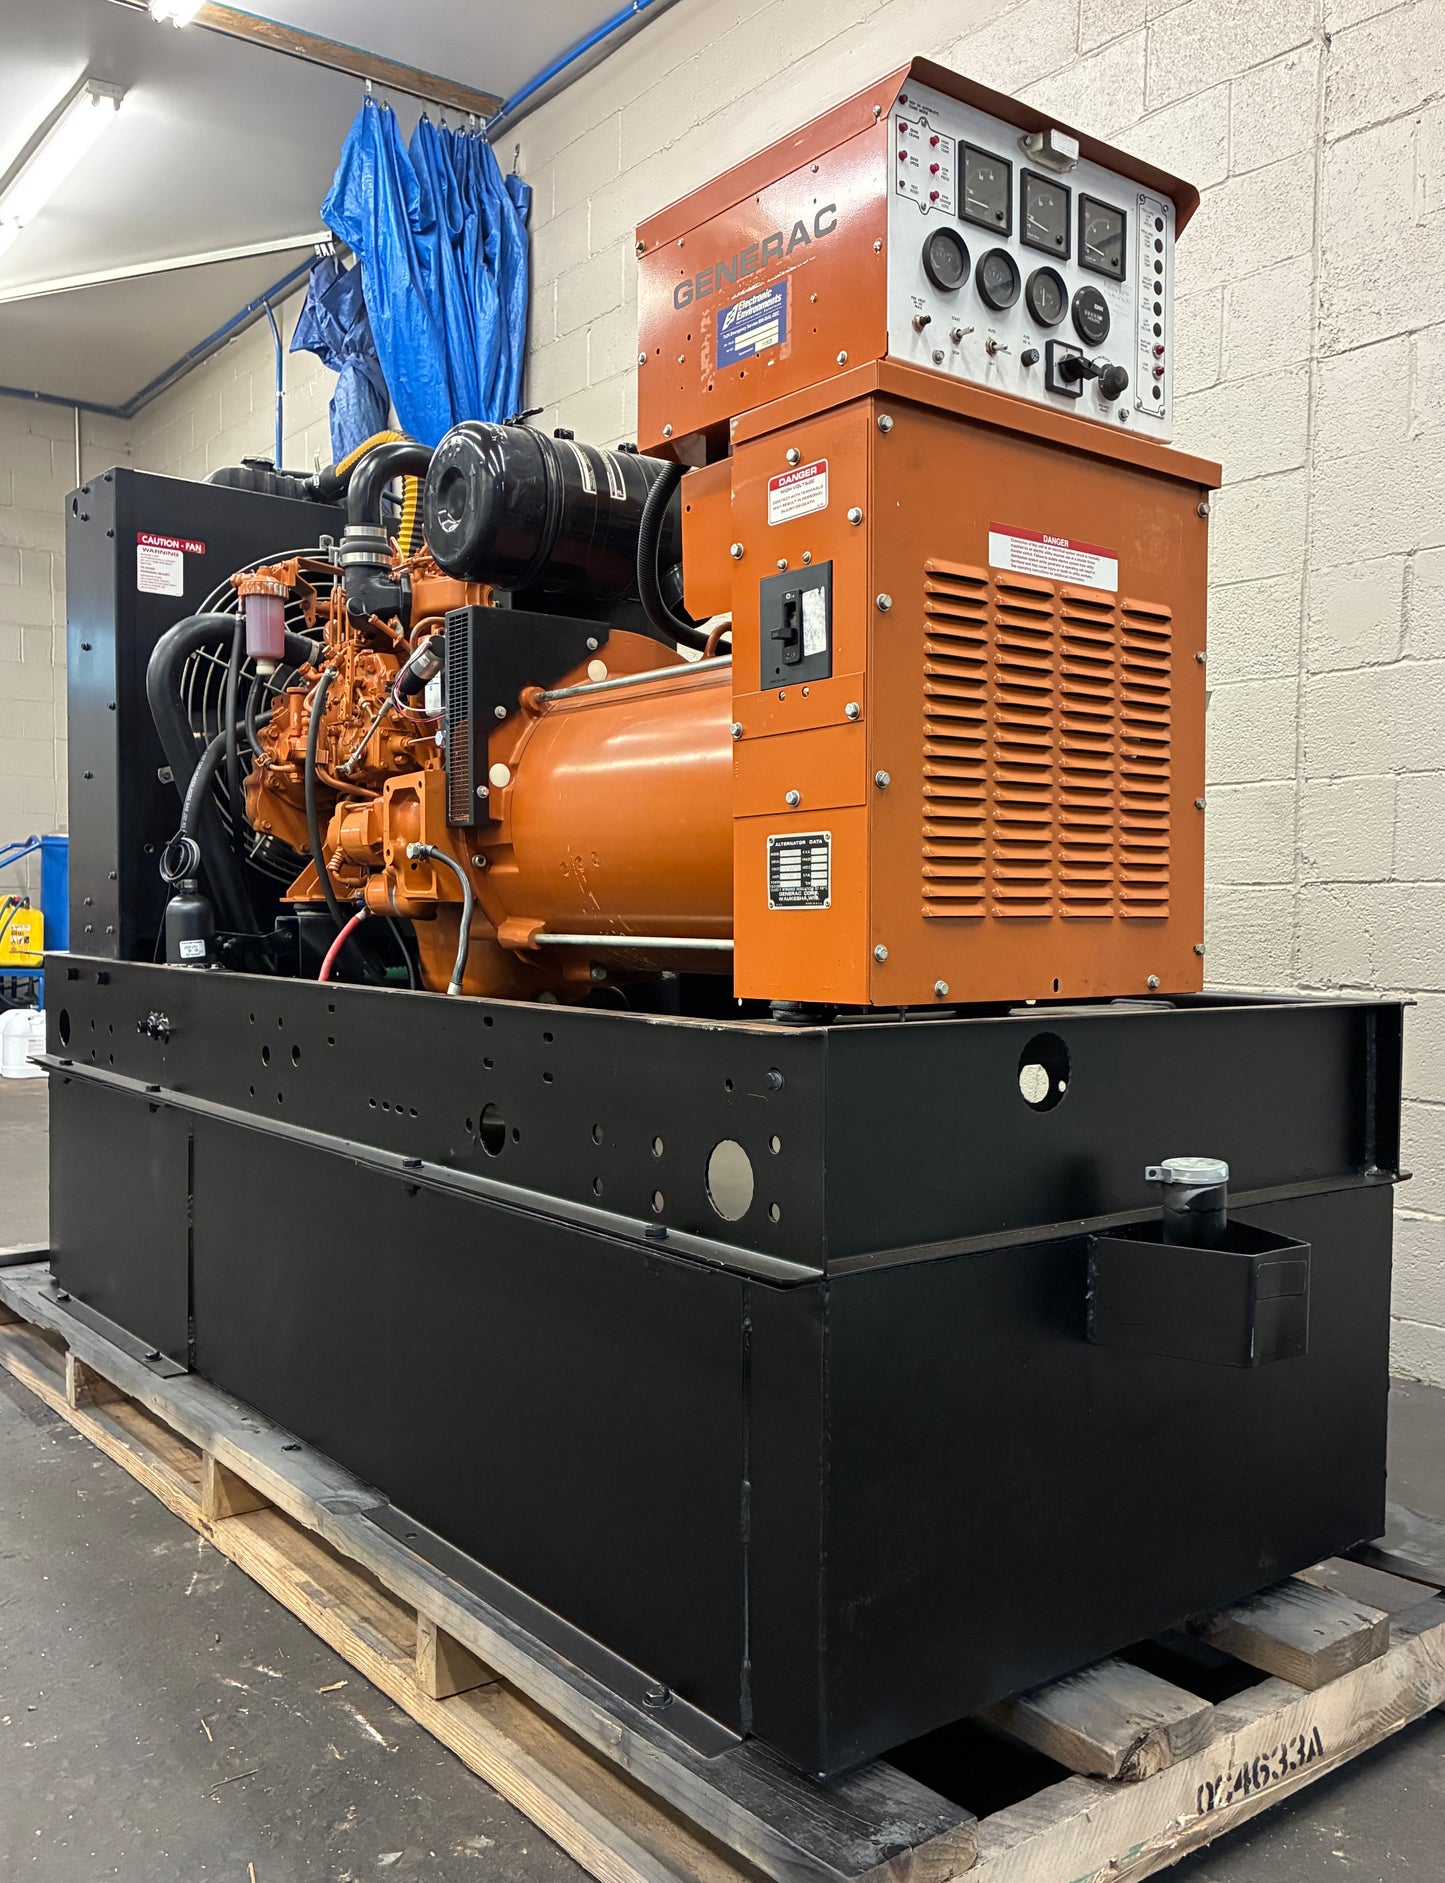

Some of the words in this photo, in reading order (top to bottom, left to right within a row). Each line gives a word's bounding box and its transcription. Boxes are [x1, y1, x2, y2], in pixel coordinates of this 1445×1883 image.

[673, 203, 838, 310] GENERAC
[737, 294, 782, 321] Environments
[738, 289, 772, 311] Electronic
[778, 466, 817, 487] DANGER
[793, 479, 814, 490] VOLTAGE
[142, 536, 179, 548] CAUTION
[186, 543, 202, 554] FAN
[1043, 535, 1069, 547] DANGER
[142, 548, 179, 557] WARNING
